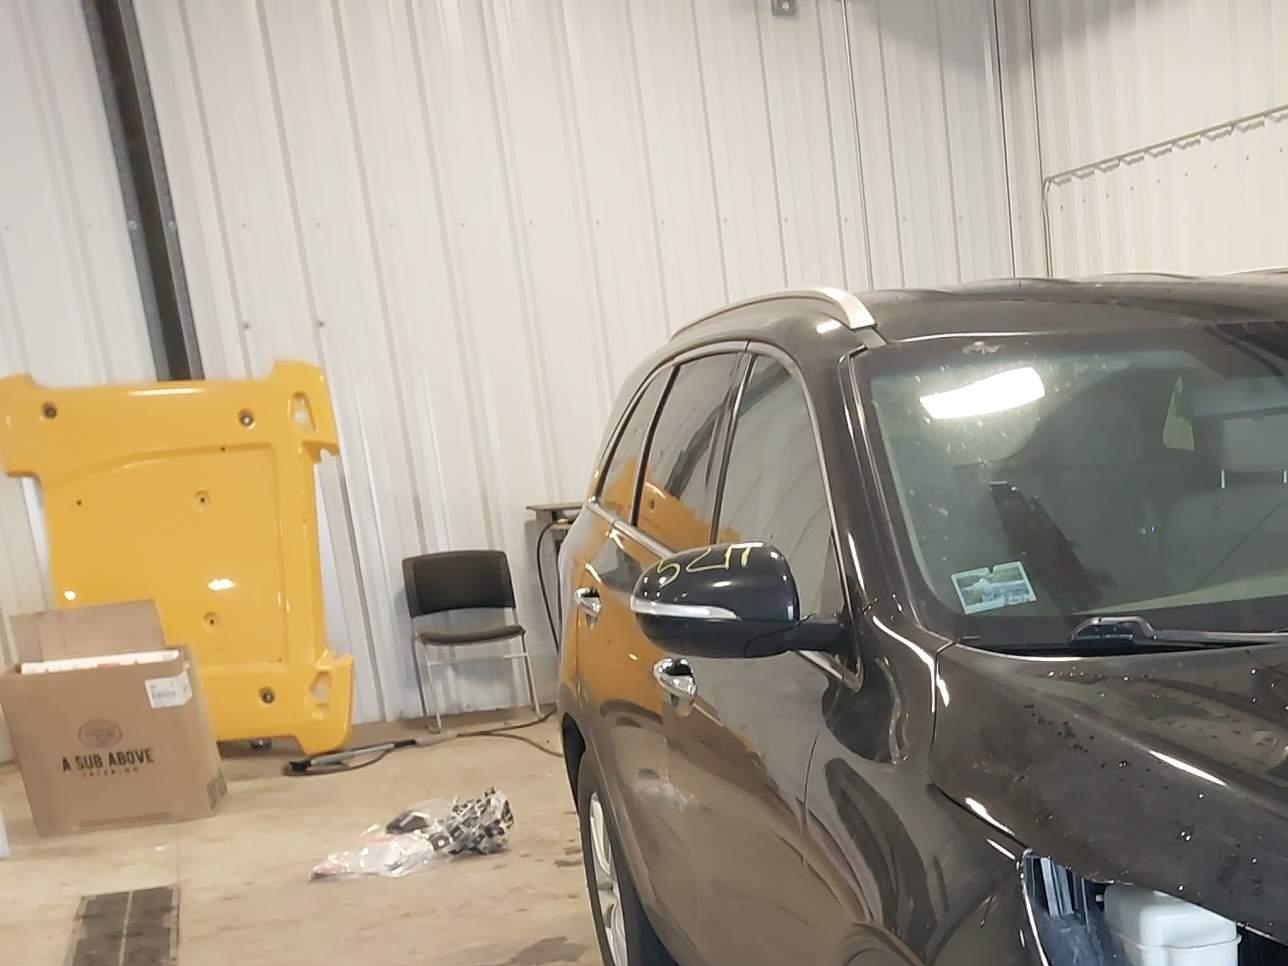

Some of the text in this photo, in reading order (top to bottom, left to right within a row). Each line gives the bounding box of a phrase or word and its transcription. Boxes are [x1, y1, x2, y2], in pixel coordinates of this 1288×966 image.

[62, 749, 154, 772] A SUB ABOVE
